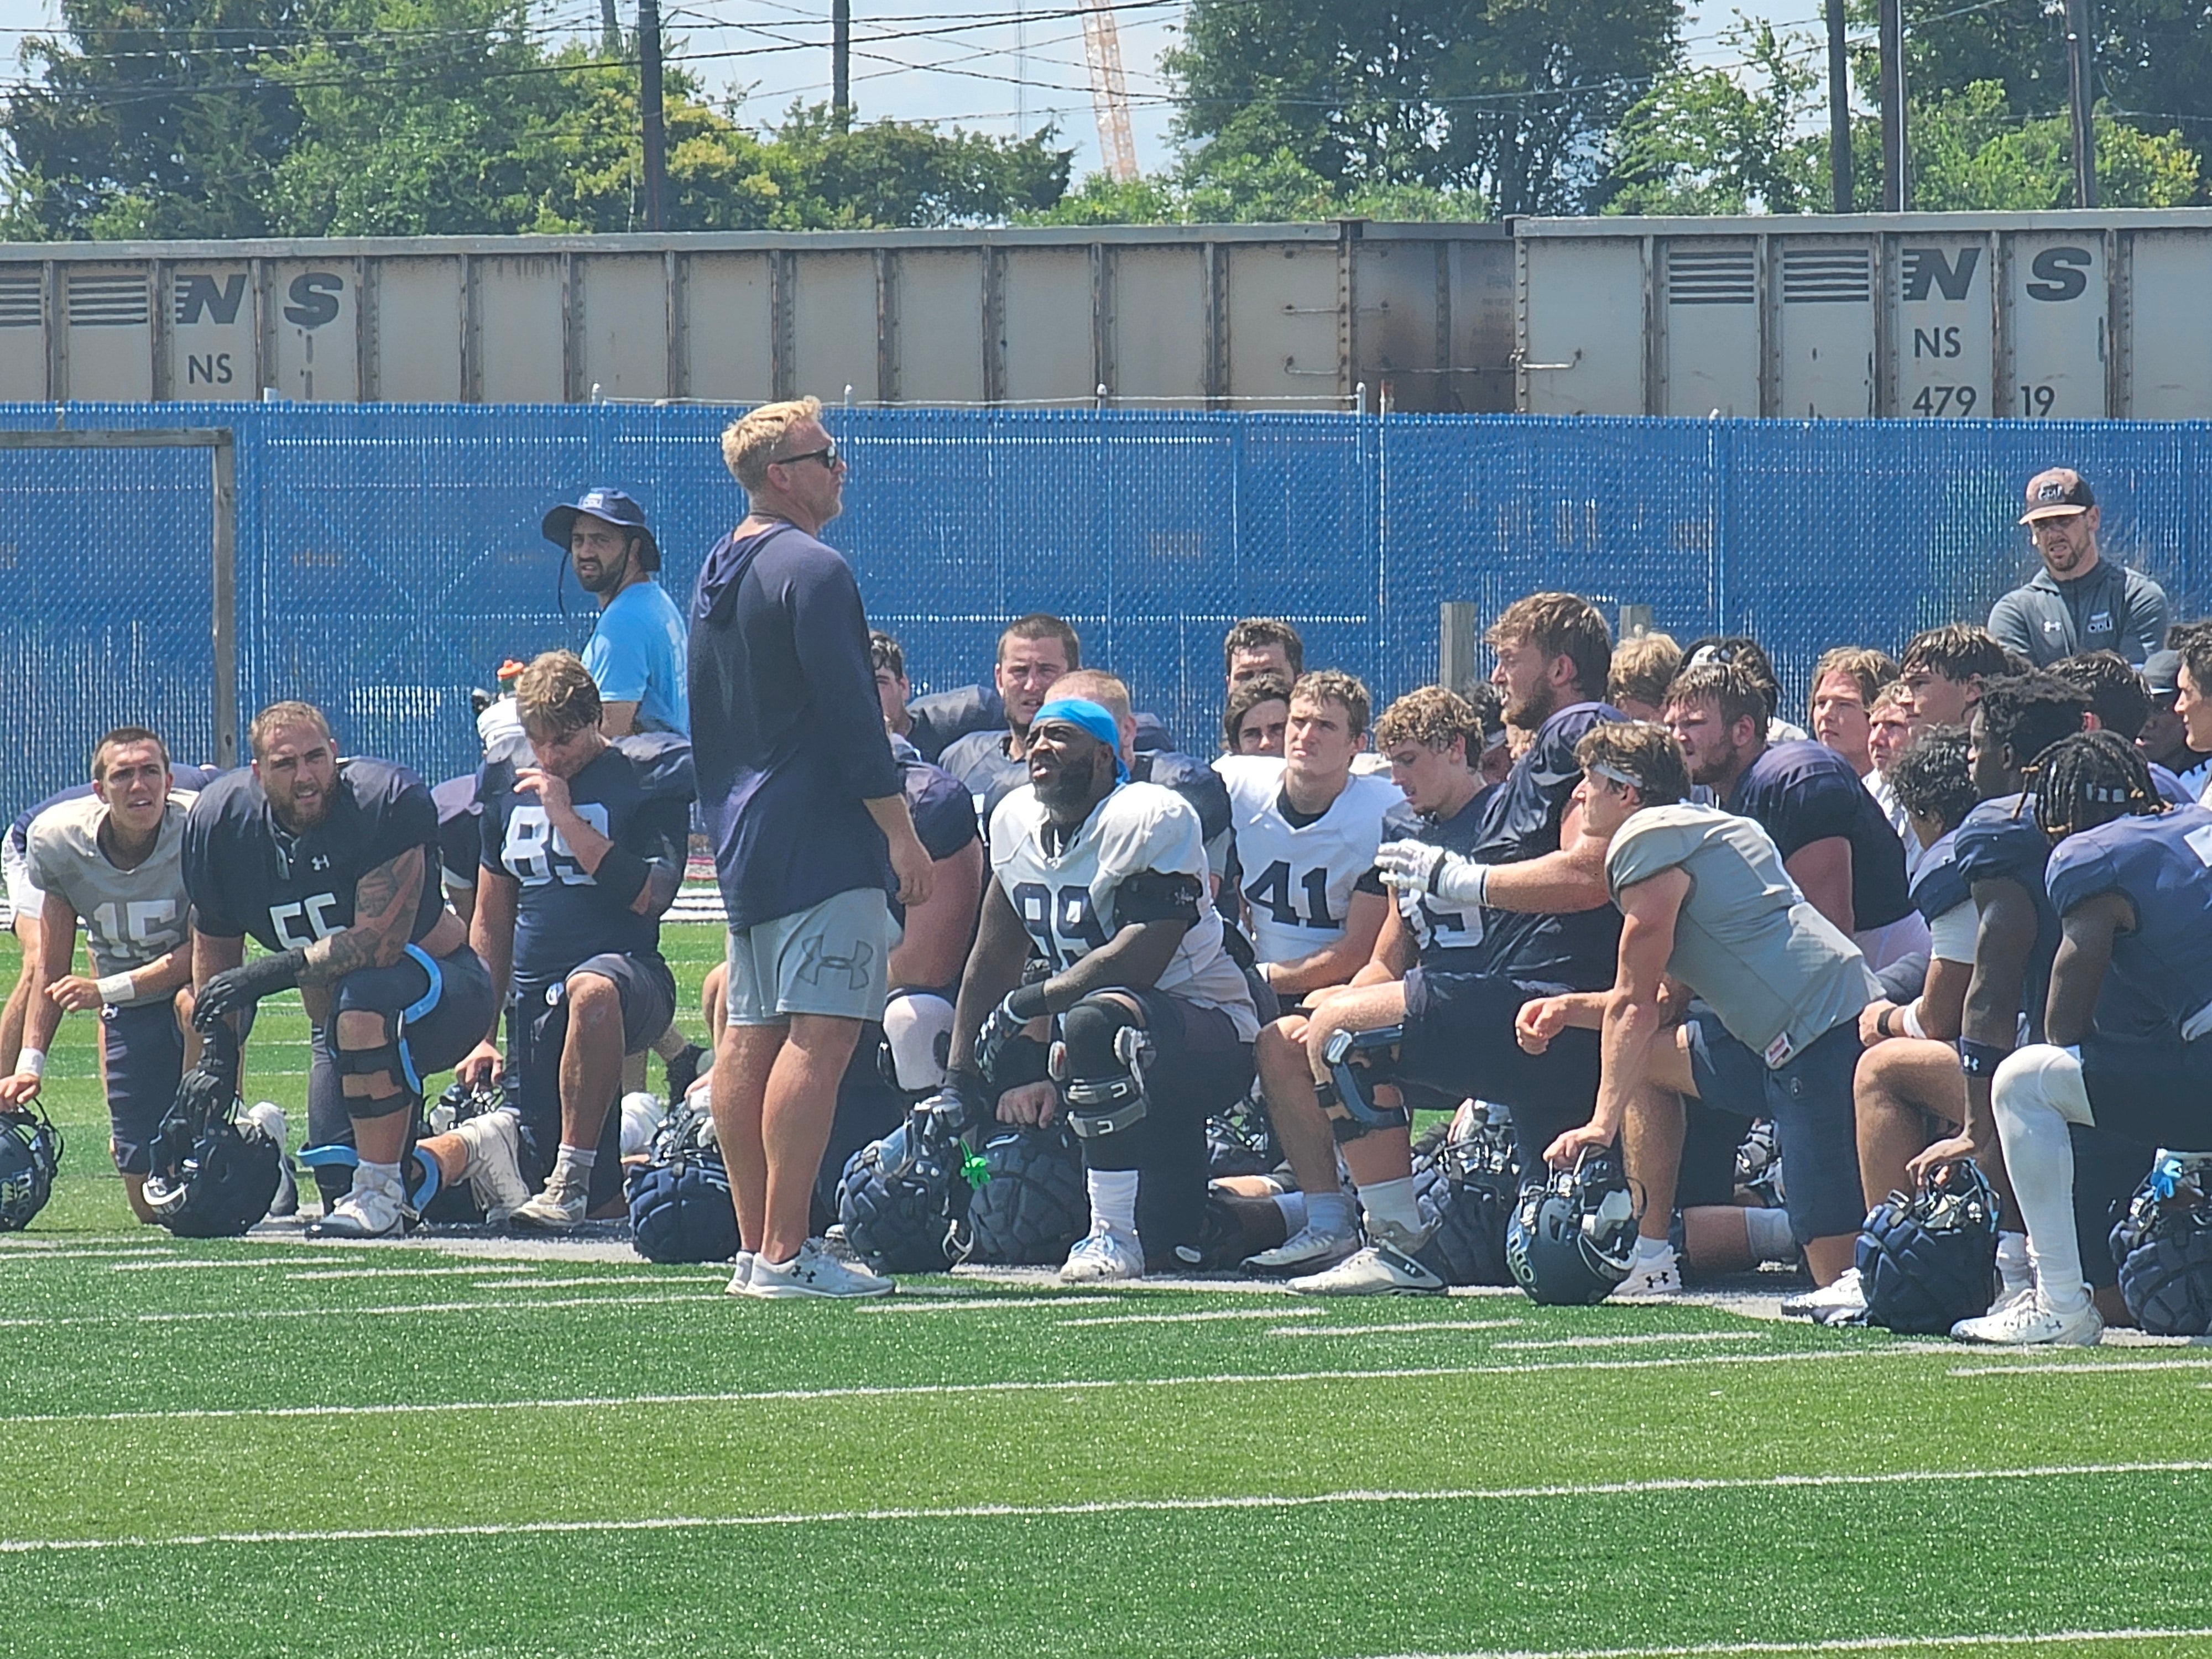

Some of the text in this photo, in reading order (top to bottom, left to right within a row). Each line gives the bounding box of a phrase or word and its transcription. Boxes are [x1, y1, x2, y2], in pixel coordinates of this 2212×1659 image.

[1914, 326, 1961, 358] NS
[188, 353, 233, 384] NS
[1912, 385, 2056, 418] 479 19
[1244, 859, 1339, 929] 41
[93, 899, 181, 963] 15
[1012, 881, 1109, 971] 99
